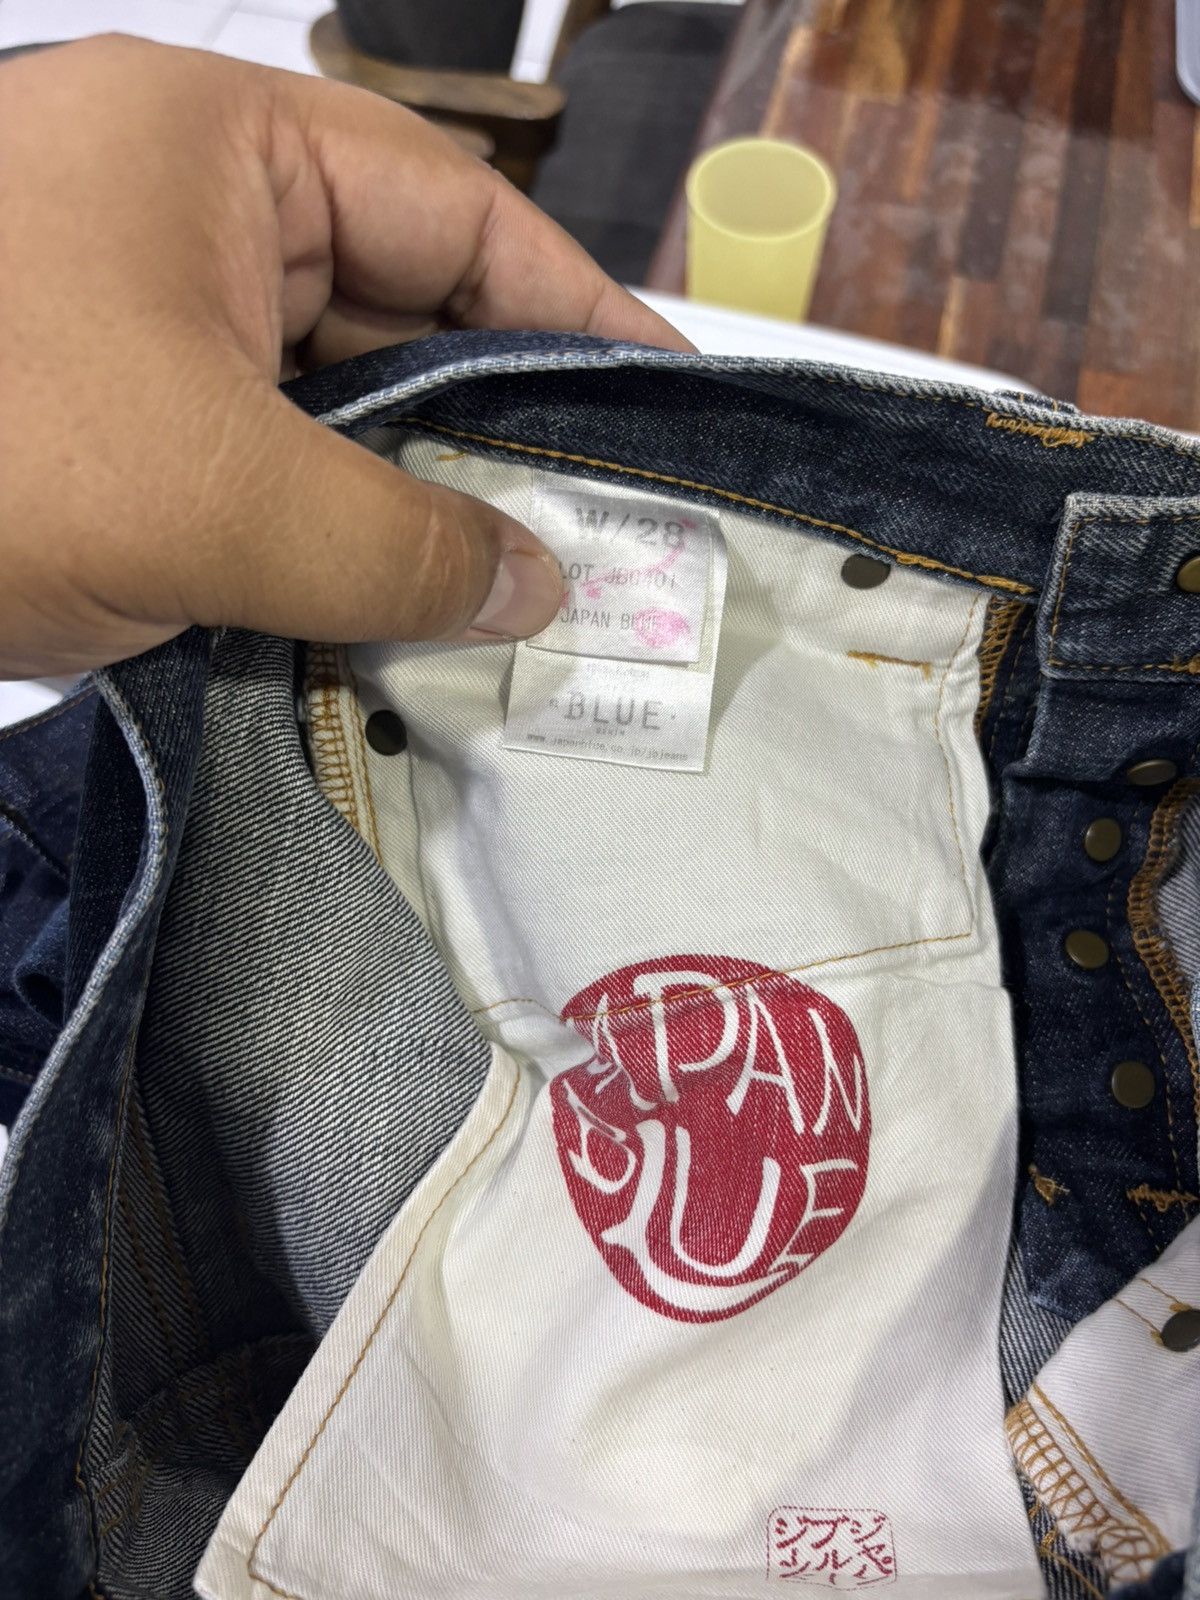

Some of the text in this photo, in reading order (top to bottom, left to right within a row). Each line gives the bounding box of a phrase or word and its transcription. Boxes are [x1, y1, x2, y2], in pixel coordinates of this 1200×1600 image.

[575, 507, 684, 548] W/28
[560, 607, 611, 629] JAPAN
[564, 690, 664, 731] BLUE
